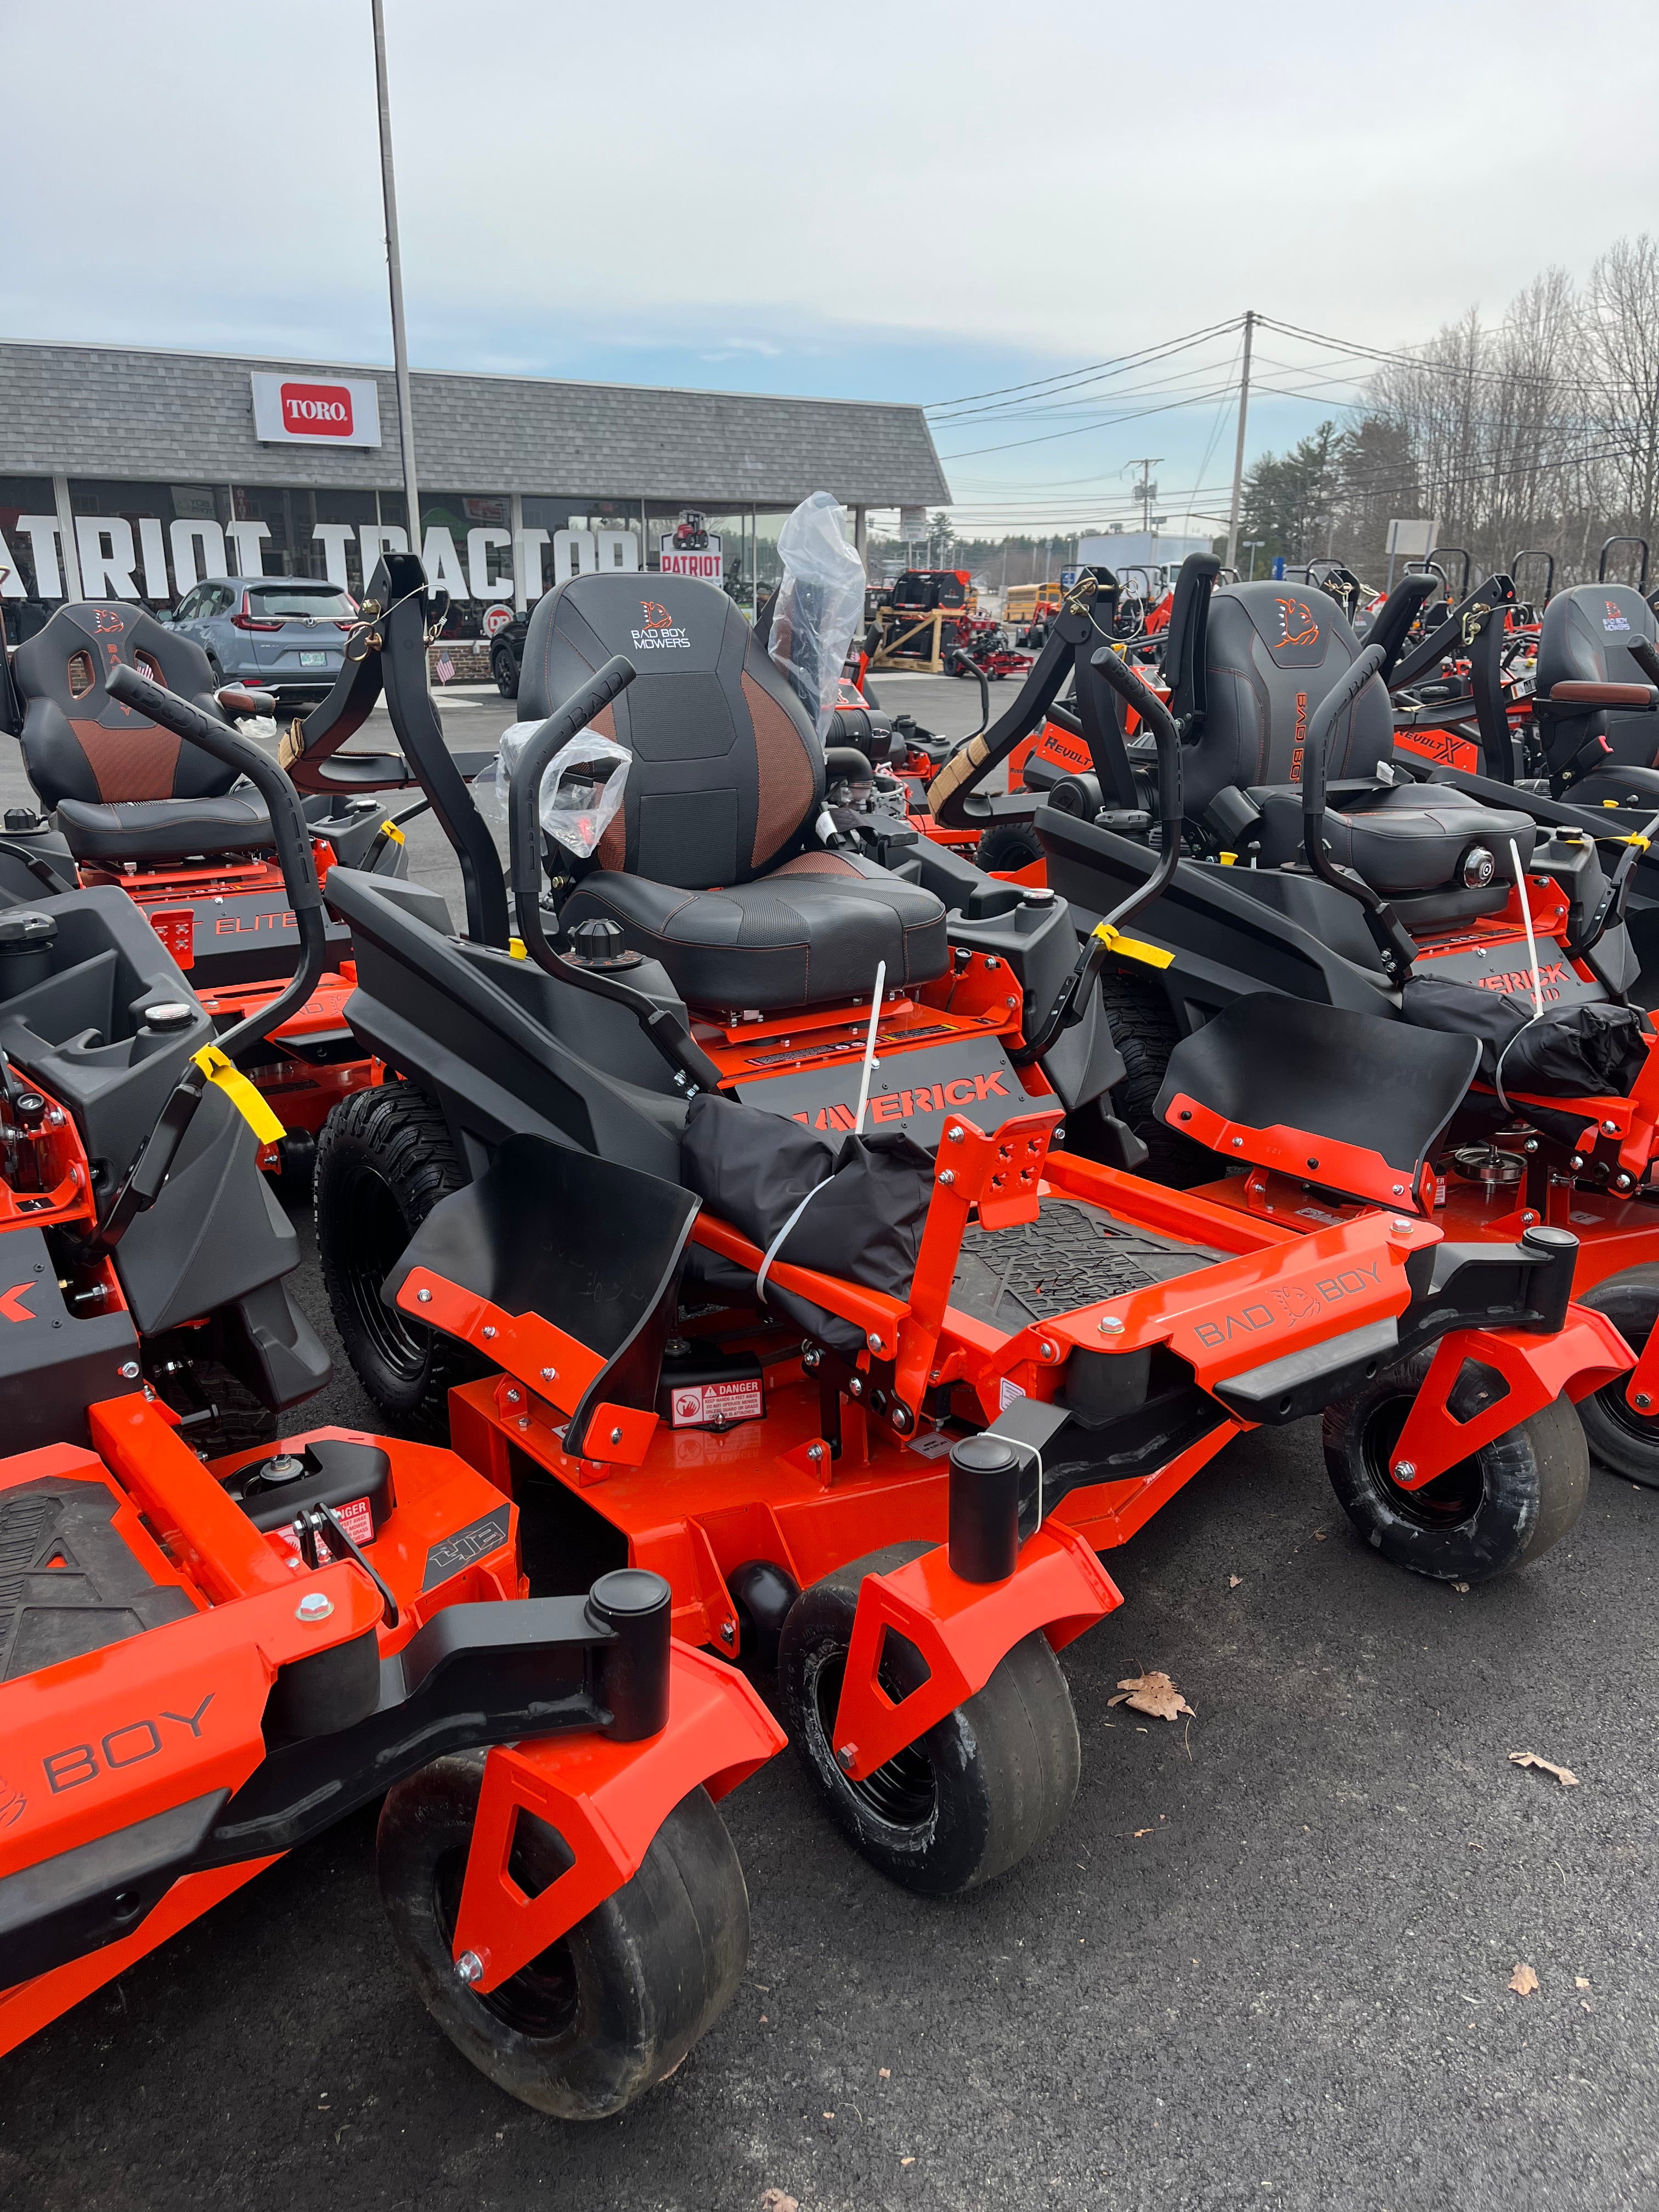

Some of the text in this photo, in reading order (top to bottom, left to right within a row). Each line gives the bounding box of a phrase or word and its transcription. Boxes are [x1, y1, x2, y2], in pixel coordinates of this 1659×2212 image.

[286, 399, 346, 421] TORO
[662, 556, 721, 577] PATRIOT
[631, 628, 686, 639] BAD BOY
[634, 638, 691, 650] MOWERS
[131, 680, 227, 740] BOY
[564, 672, 624, 734] BAD
[1295, 693, 1307, 742] BAD
[216, 911, 298, 935] ELITE
[1194, 1262, 1381, 1347] BAD BOY
[719, 1381, 758, 1395] DANGER
[348, 1521, 368, 1531] MOWER
[352, 1526, 369, 1536] GRASS
[42, 1692, 216, 1795] BOY
